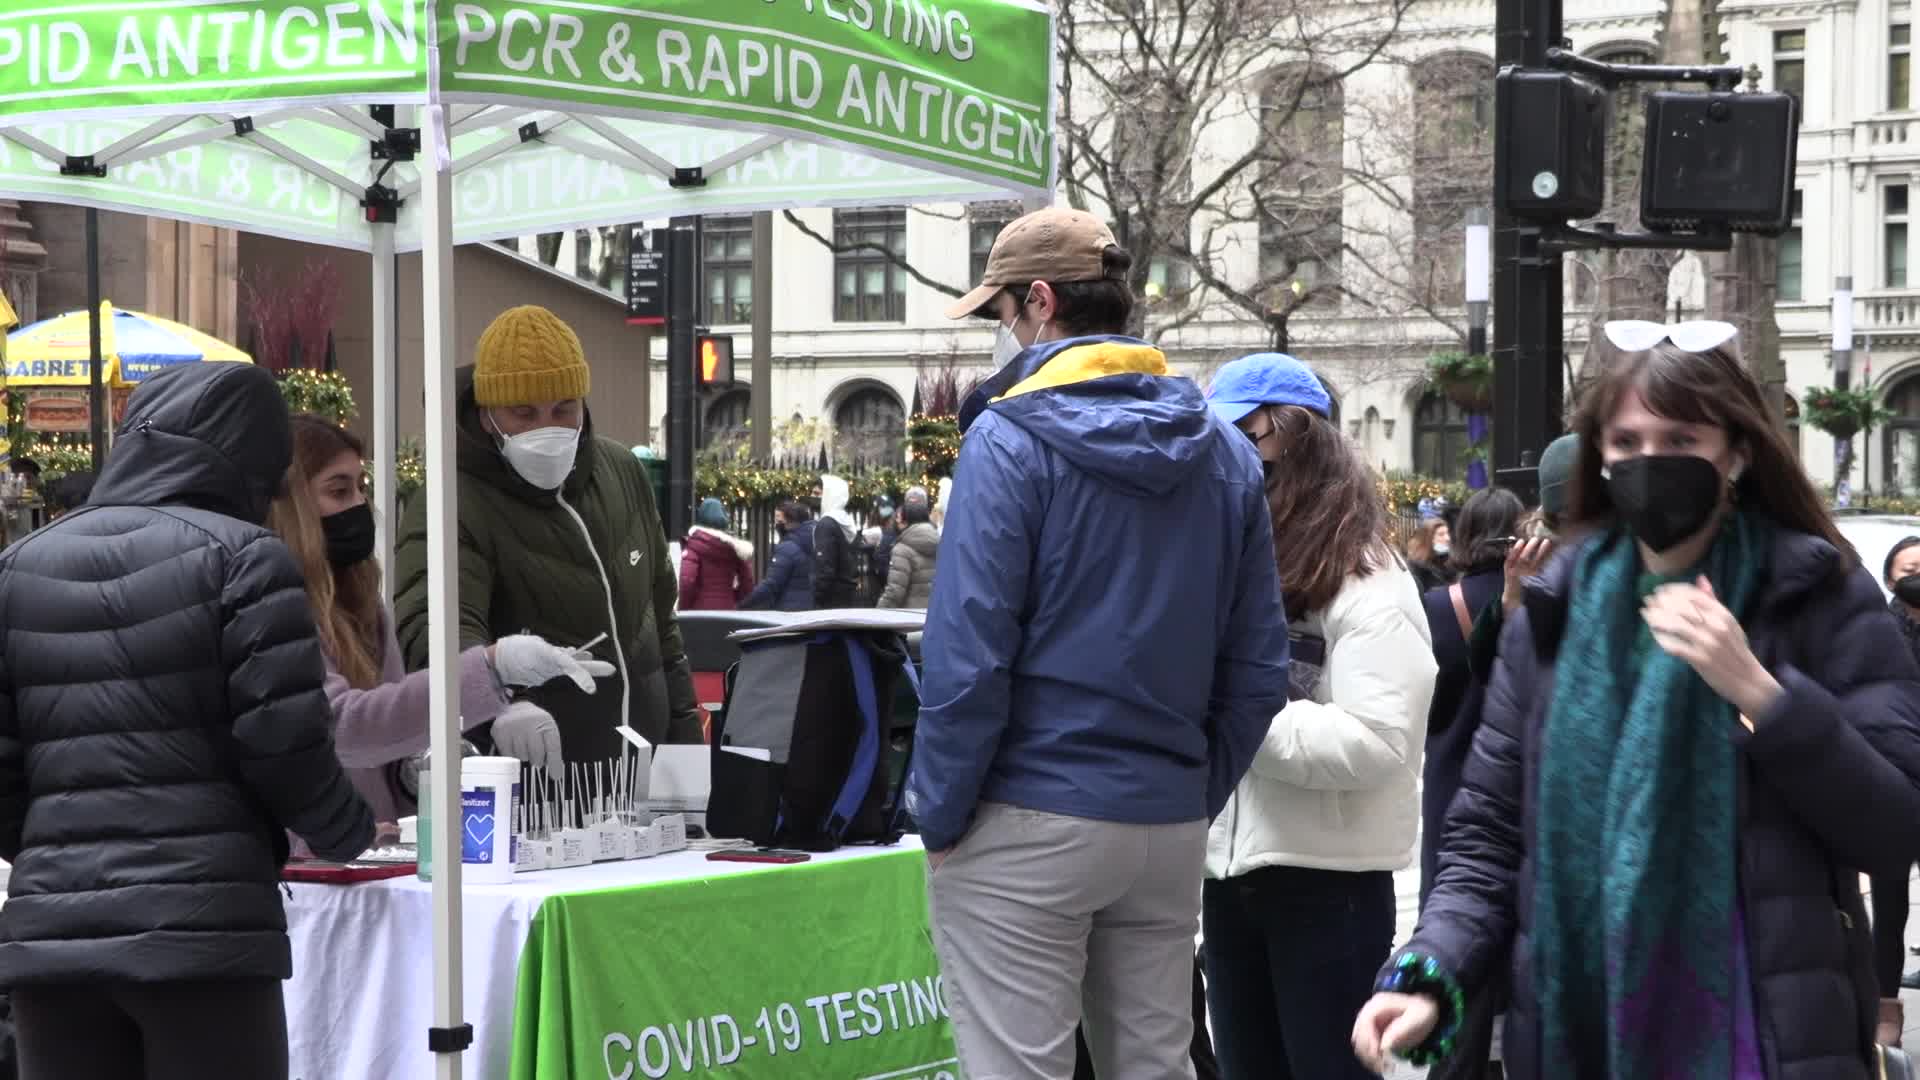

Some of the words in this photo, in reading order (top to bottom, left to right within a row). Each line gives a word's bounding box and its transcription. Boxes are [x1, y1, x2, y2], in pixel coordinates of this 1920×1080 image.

[108, 0, 418, 80] ANTIGEN
[453, 4, 582, 79] PCR
[599, 22, 644, 84] &
[657, 29, 822, 109] RAPID
[837, 64, 1045, 168] ANTIGEN
[603, 1002, 800, 1080] COVID-19
